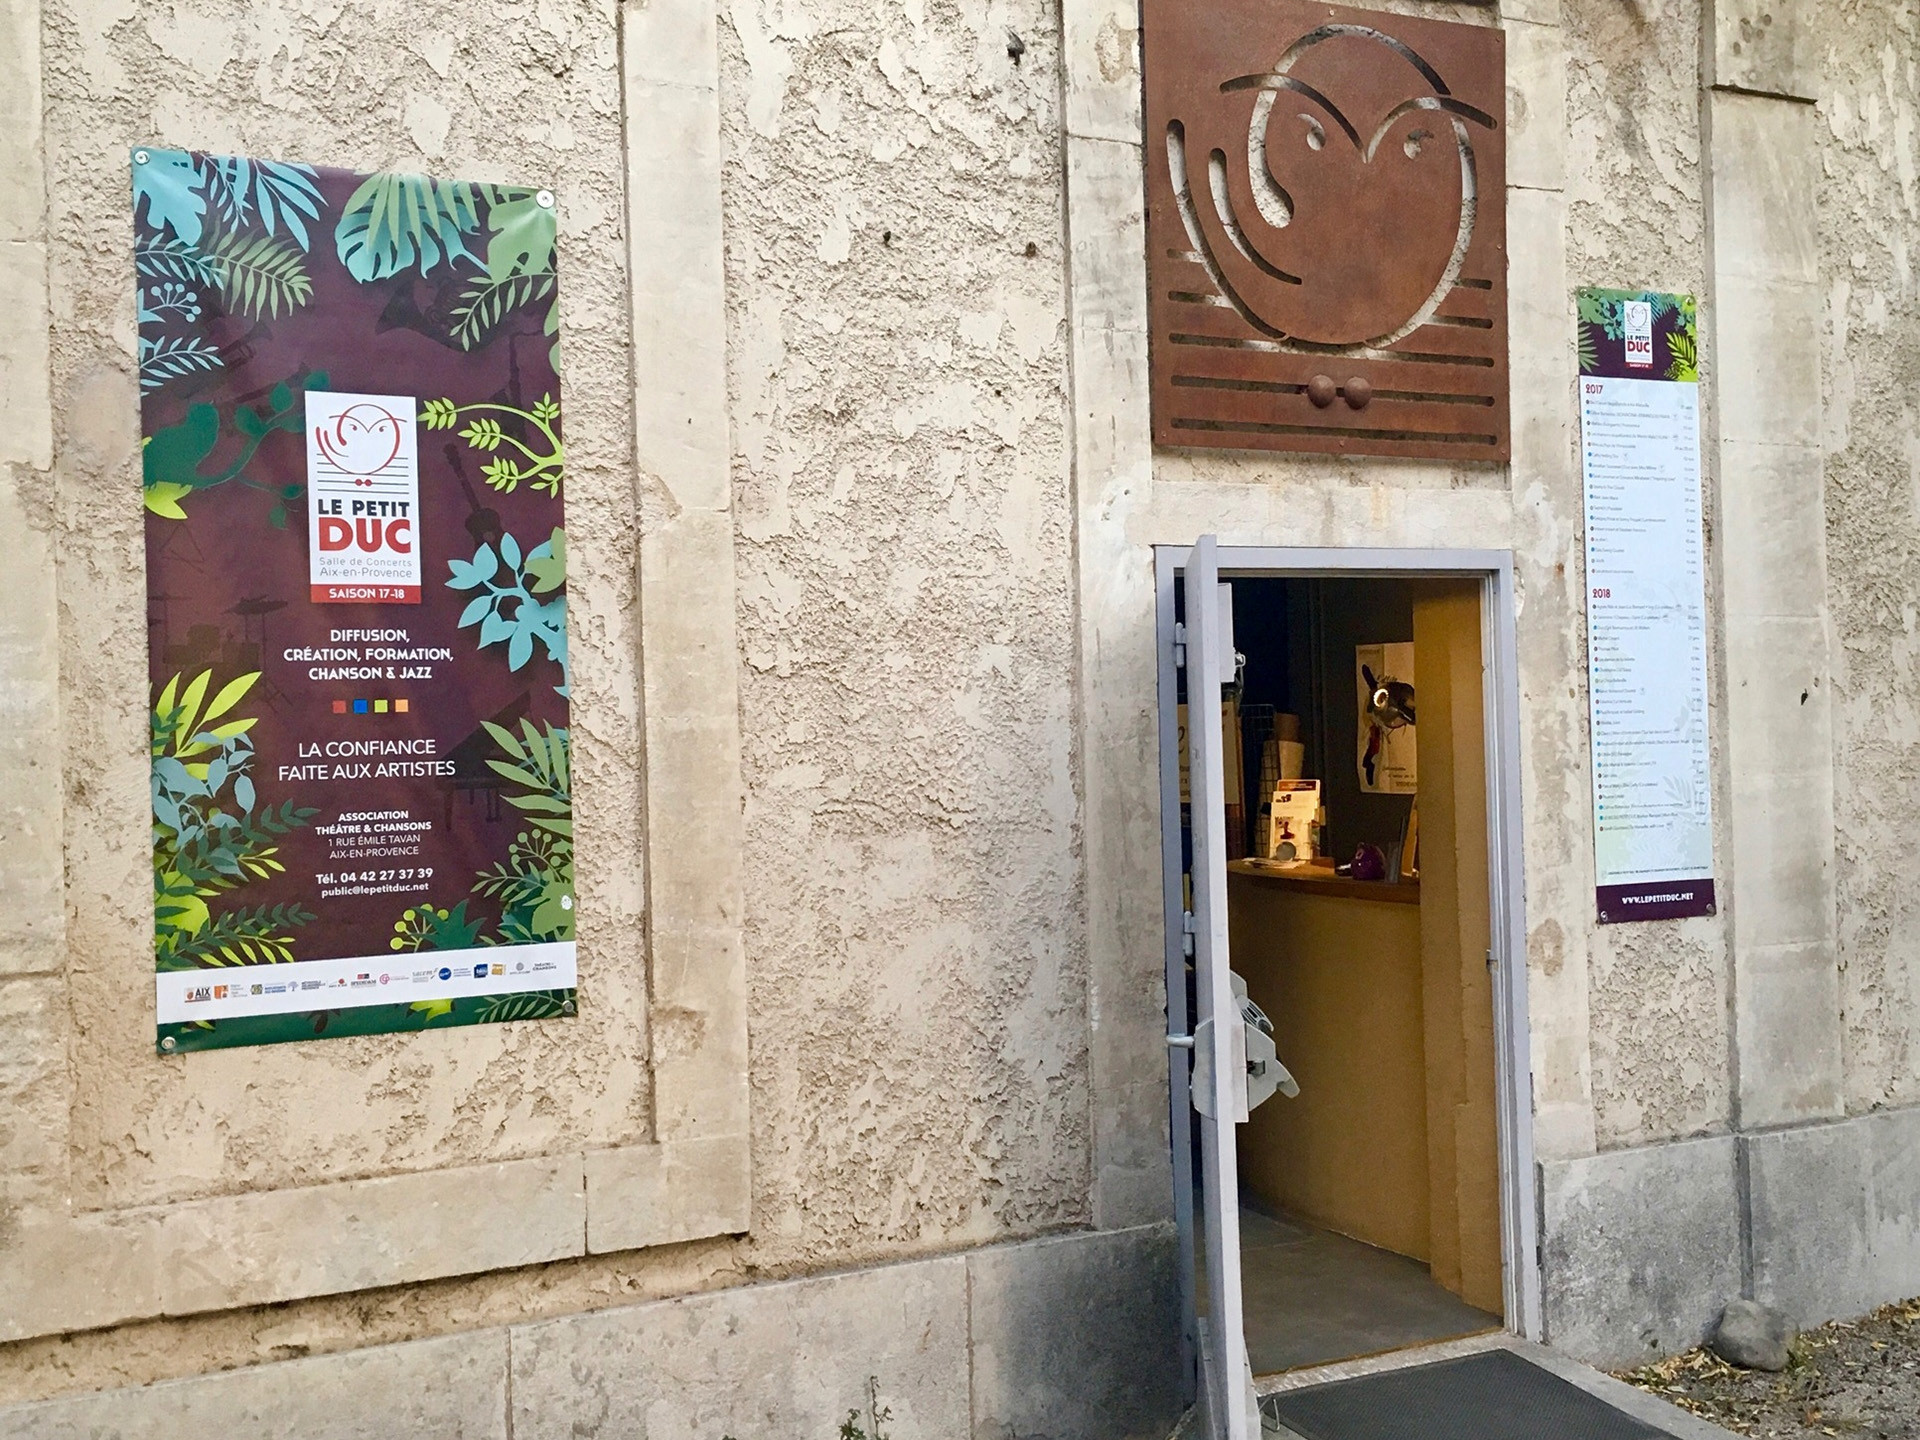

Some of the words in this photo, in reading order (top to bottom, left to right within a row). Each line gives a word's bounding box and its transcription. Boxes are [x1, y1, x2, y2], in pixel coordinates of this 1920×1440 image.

[1627, 341, 1650, 353] DUC
[1585, 383, 1603, 394] 2017
[318, 499, 342, 515] LE
[352, 500, 410, 517] PETIT
[318, 517, 411, 553] DUC
[319, 557, 346, 566] Salle
[349, 557, 362, 566] de
[366, 558, 412, 567] Concerts
[319, 567, 412, 578] Aix-en-Provence
[329, 588, 376, 599] SAISON
[379, 588, 405, 599] 17-18
[1592, 588, 1611, 598] 2018
[330, 629, 410, 643] DIFFUSION,
[283, 646, 361, 662] CRÉATION,
[365, 647, 454, 662] FORMATION,
[308, 667, 382, 680] CHANSON
[386, 666, 396, 679] &
[399, 666, 432, 679] JAZZ
[299, 742, 322, 758] LA
[325, 739, 436, 757] CONFIANCE
[278, 764, 328, 781] FAITE
[332, 763, 371, 779] AUX
[374, 760, 456, 778] ARTISTES
[338, 810, 409, 822] ASSOCIATION
[315, 824, 361, 835] THÉÂTRE
[363, 824, 372, 833] &
[374, 821, 432, 832] CHANSONS
[328, 838, 333, 846] 1
[336, 837, 355, 847] RUE
[358, 835, 386, 846] ÉMILE
[388, 834, 421, 844] TAVAN
[329, 846, 419, 859] AIX-EN-PROVENCE
[315, 873, 338, 884] Tél.
[340, 872, 357, 883] 04
[360, 871, 376, 881] 42
[379, 869, 395, 880] 27
[398, 868, 414, 879] 37
[417, 867, 433, 878] 39
[321, 882, 429, 898] public@lepetitduc.net
[1622, 892, 1694, 904] WWW.LEPETITDUC.NET
[195, 987, 211, 997] AIX
